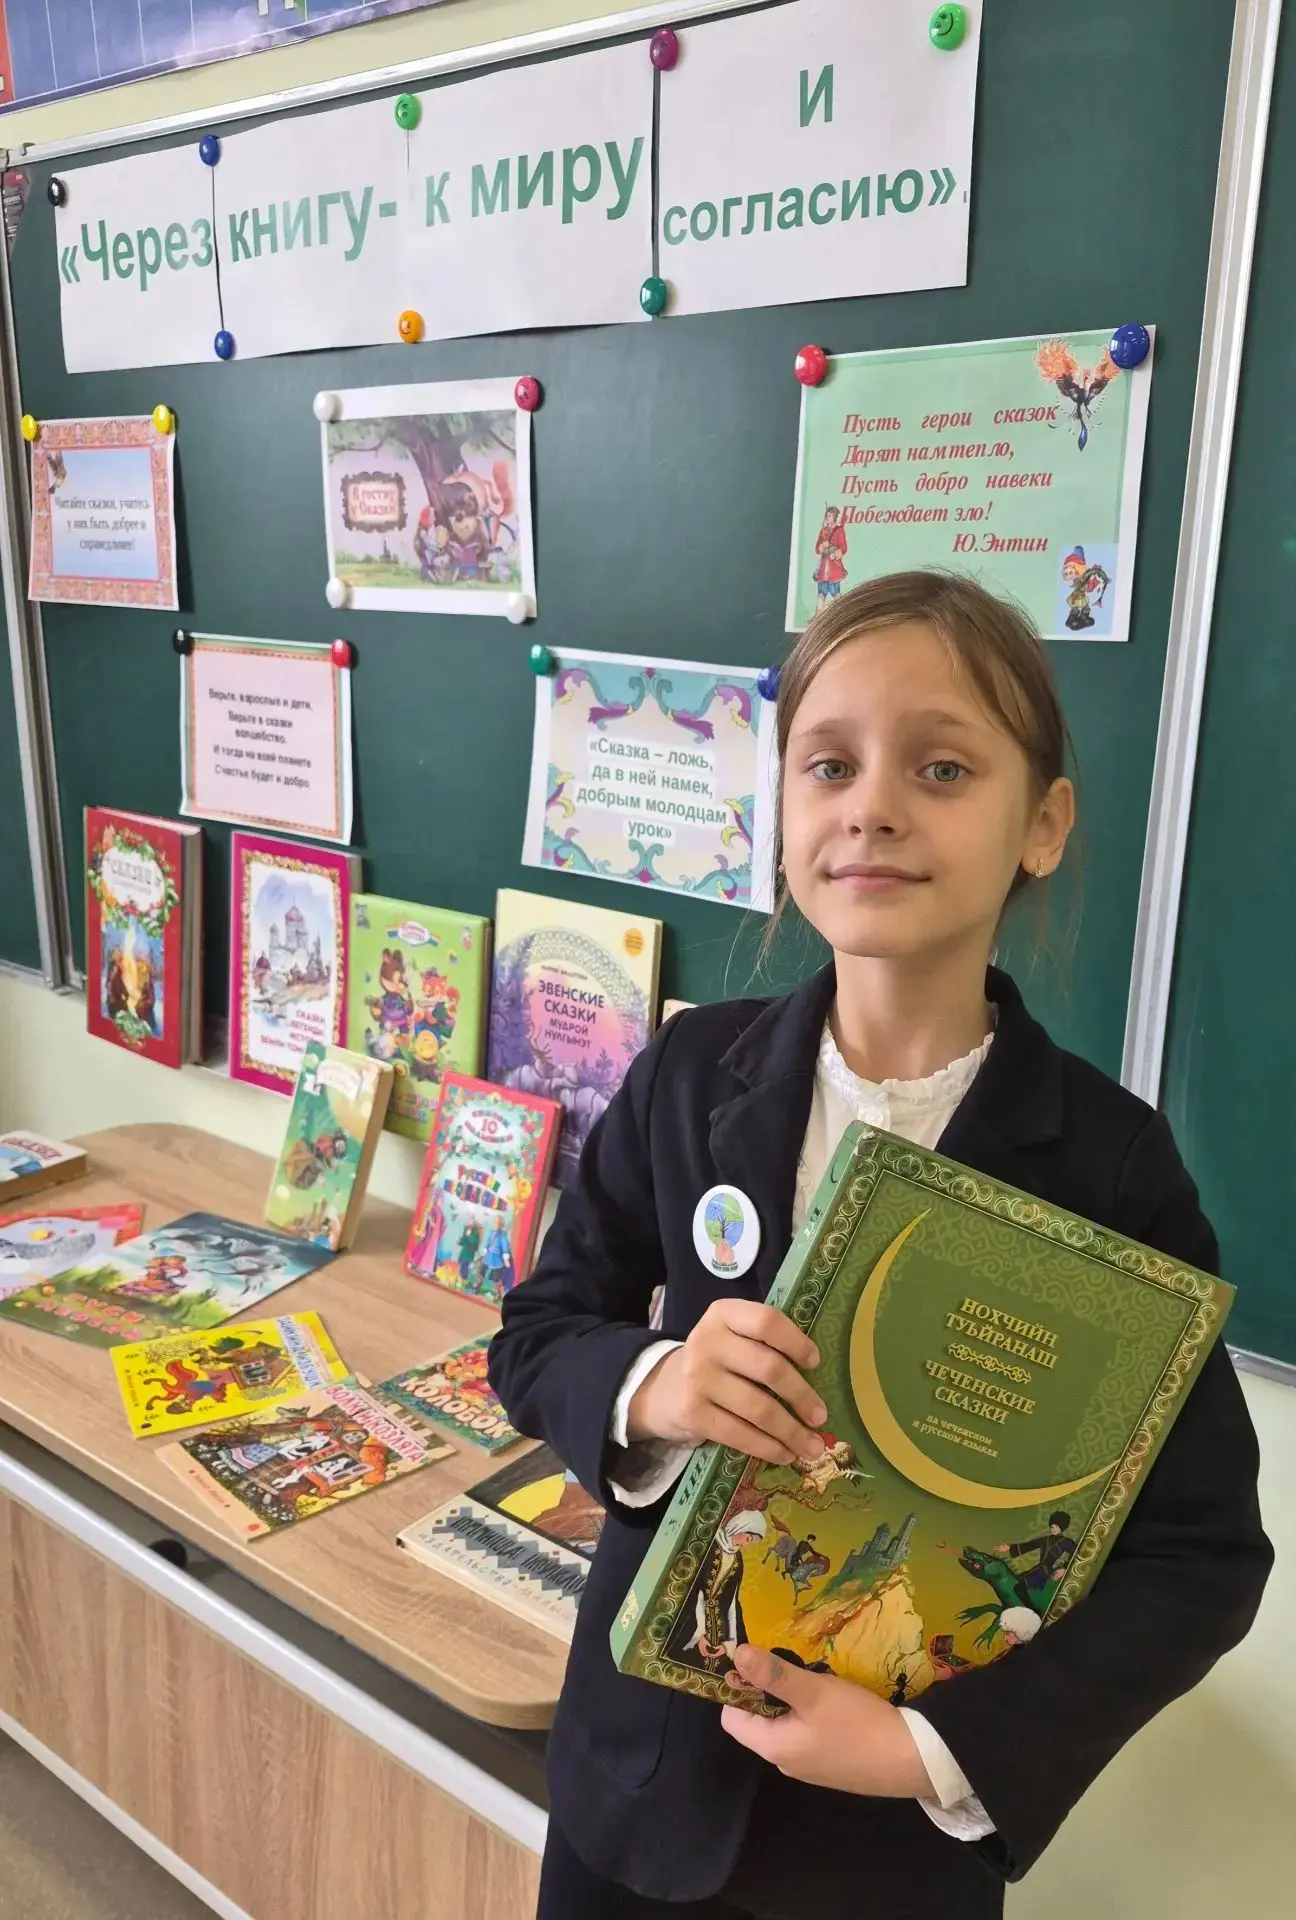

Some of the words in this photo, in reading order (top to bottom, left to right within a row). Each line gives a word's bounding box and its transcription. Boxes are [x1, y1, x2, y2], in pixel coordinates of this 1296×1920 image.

[799, 64, 835, 128] и
[60, 217, 213, 291] «Через
[230, 185, 397, 262] книгу-
[424, 171, 451, 227] к
[471, 137, 645, 223] миру
[842, 413, 901, 436] Пусть
[921, 411, 972, 432] герои
[993, 405, 1058, 425] сказок
[841, 445, 901, 467] Дарят
[841, 475, 899, 497] Пусть
[915, 472, 968, 498] добро
[985, 472, 1053, 490] навеки
[842, 503, 948, 525] Побеждает
[953, 501, 993, 522] зло!
[952, 533, 1049, 553] Ю.Энтин
[589, 737, 649, 760] «Сказка
[668, 750, 714, 771] ложь,
[592, 764, 610, 781] да
[616, 768, 624, 781] в
[629, 767, 656, 787] ней
[661, 774, 713, 798] намек,
[577, 785, 640, 810] добрым
[646, 797, 727, 825] молодцам
[628, 821, 672, 840] урок»
[538, 980, 605, 1008] ЭВЕНСКИЕ
[544, 999, 596, 1024] СКАЗКИ
[550, 1018, 588, 1036] МУДРОЙ
[960, 1298, 1058, 1348] НОХЧИЙН
[944, 1312, 1059, 1369] ТУЬЙРАНАШ
[926, 1359, 1036, 1414] ЧЕЧЕНСКИЕ
[399, 1376, 514, 1439] КОЛОБОК
[935, 1386, 1010, 1424] СКАЗКИ
[920, 1422, 960, 1444] русском
[926, 1415, 939, 1425] на
[941, 1419, 993, 1445] чеченском
